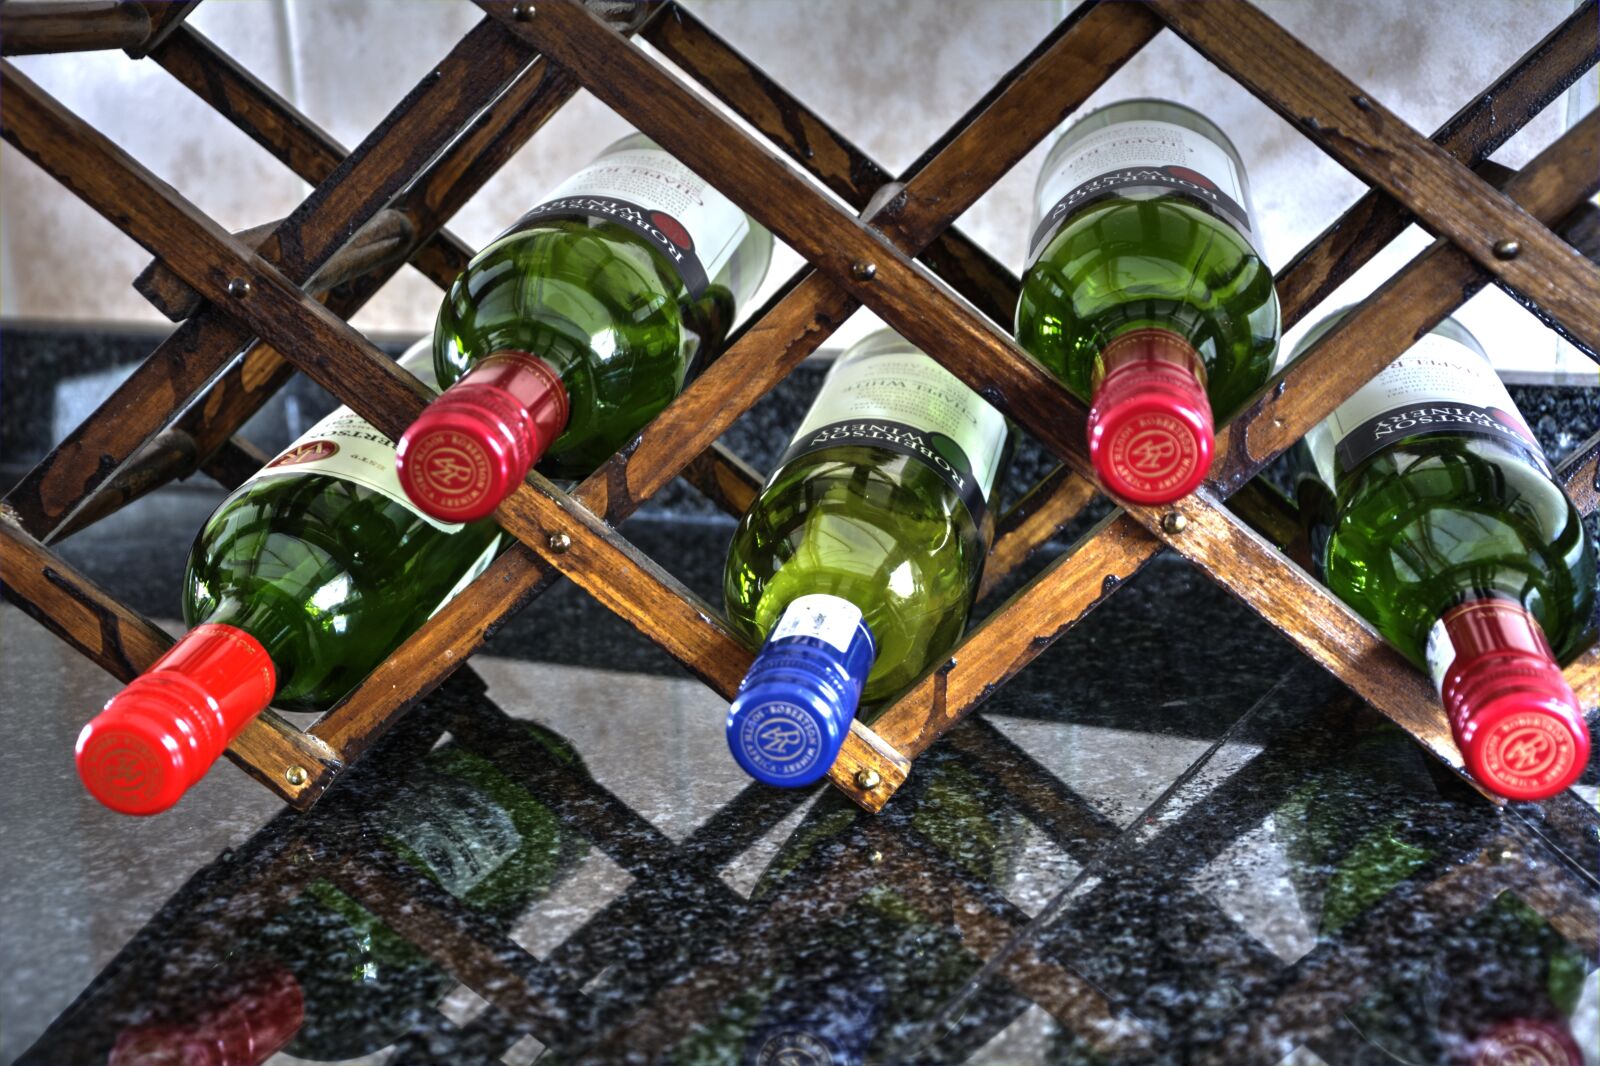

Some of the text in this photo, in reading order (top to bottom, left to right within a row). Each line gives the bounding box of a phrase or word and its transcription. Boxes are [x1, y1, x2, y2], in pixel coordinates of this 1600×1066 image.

[1052, 174, 1219, 220] ROBERTSON
[525, 202, 684, 264] ROBERTSON
[814, 423, 925, 446] WINERY
[1374, 407, 1494, 433] WINERY
[810, 430, 965, 490] ROBERTSON
